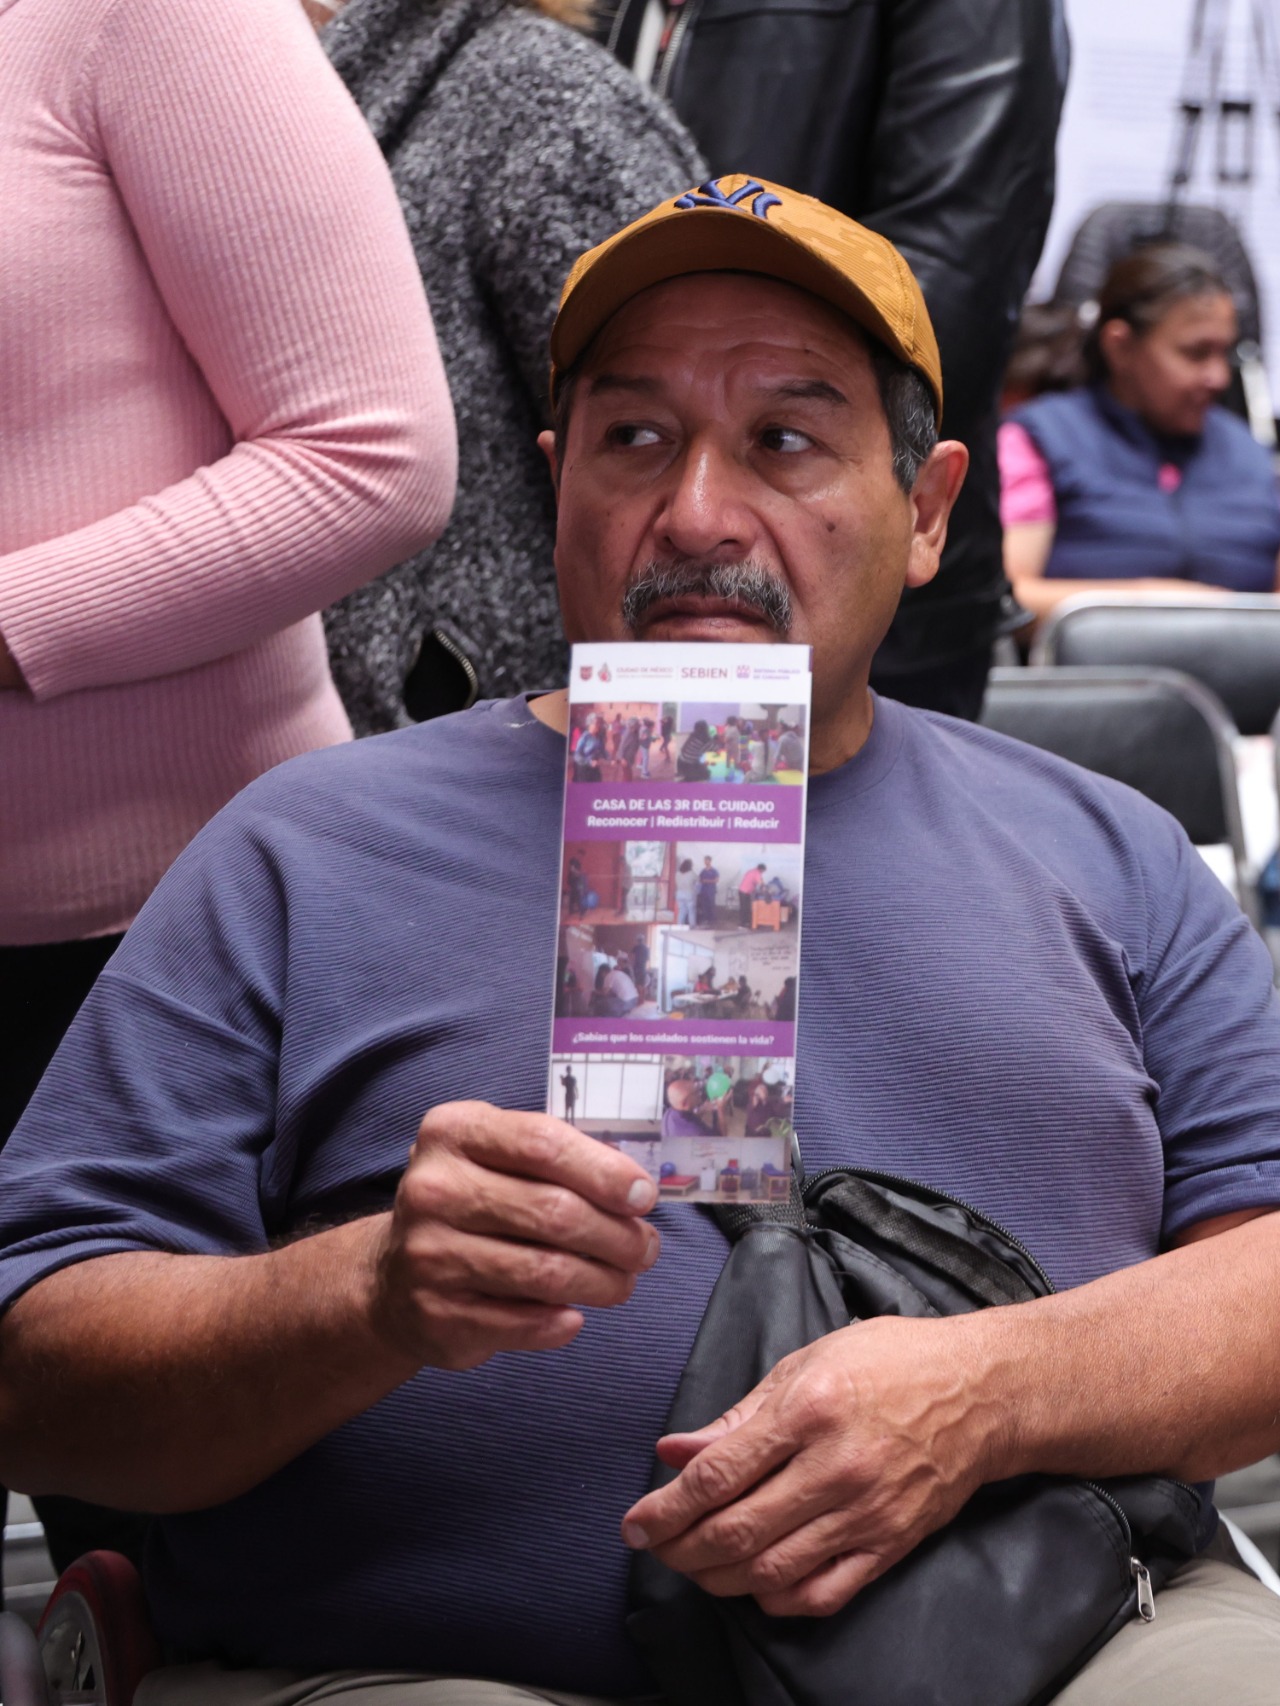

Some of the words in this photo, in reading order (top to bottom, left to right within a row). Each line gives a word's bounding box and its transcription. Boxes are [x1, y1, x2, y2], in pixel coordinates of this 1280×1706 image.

[681, 667, 728, 679] SEBIEN
[593, 799, 627, 811] CASA
[629, 799, 646, 811] DE
[647, 799, 672, 811] LAS
[674, 799, 690, 811] 3R
[693, 799, 716, 811] DEL
[718, 800, 775, 812] CUIDADO
[587, 815, 649, 827] Reconocer
[656, 816, 725, 828] Redistribuir
[734, 817, 780, 829] Reducir
[609, 1034, 628, 1044] que
[629, 1032, 644, 1042] los
[645, 1033, 688, 1043] cuidados
[690, 1034, 737, 1044] sostienen
[738, 1035, 748, 1044] la
[749, 1035, 775, 1045] vida?
